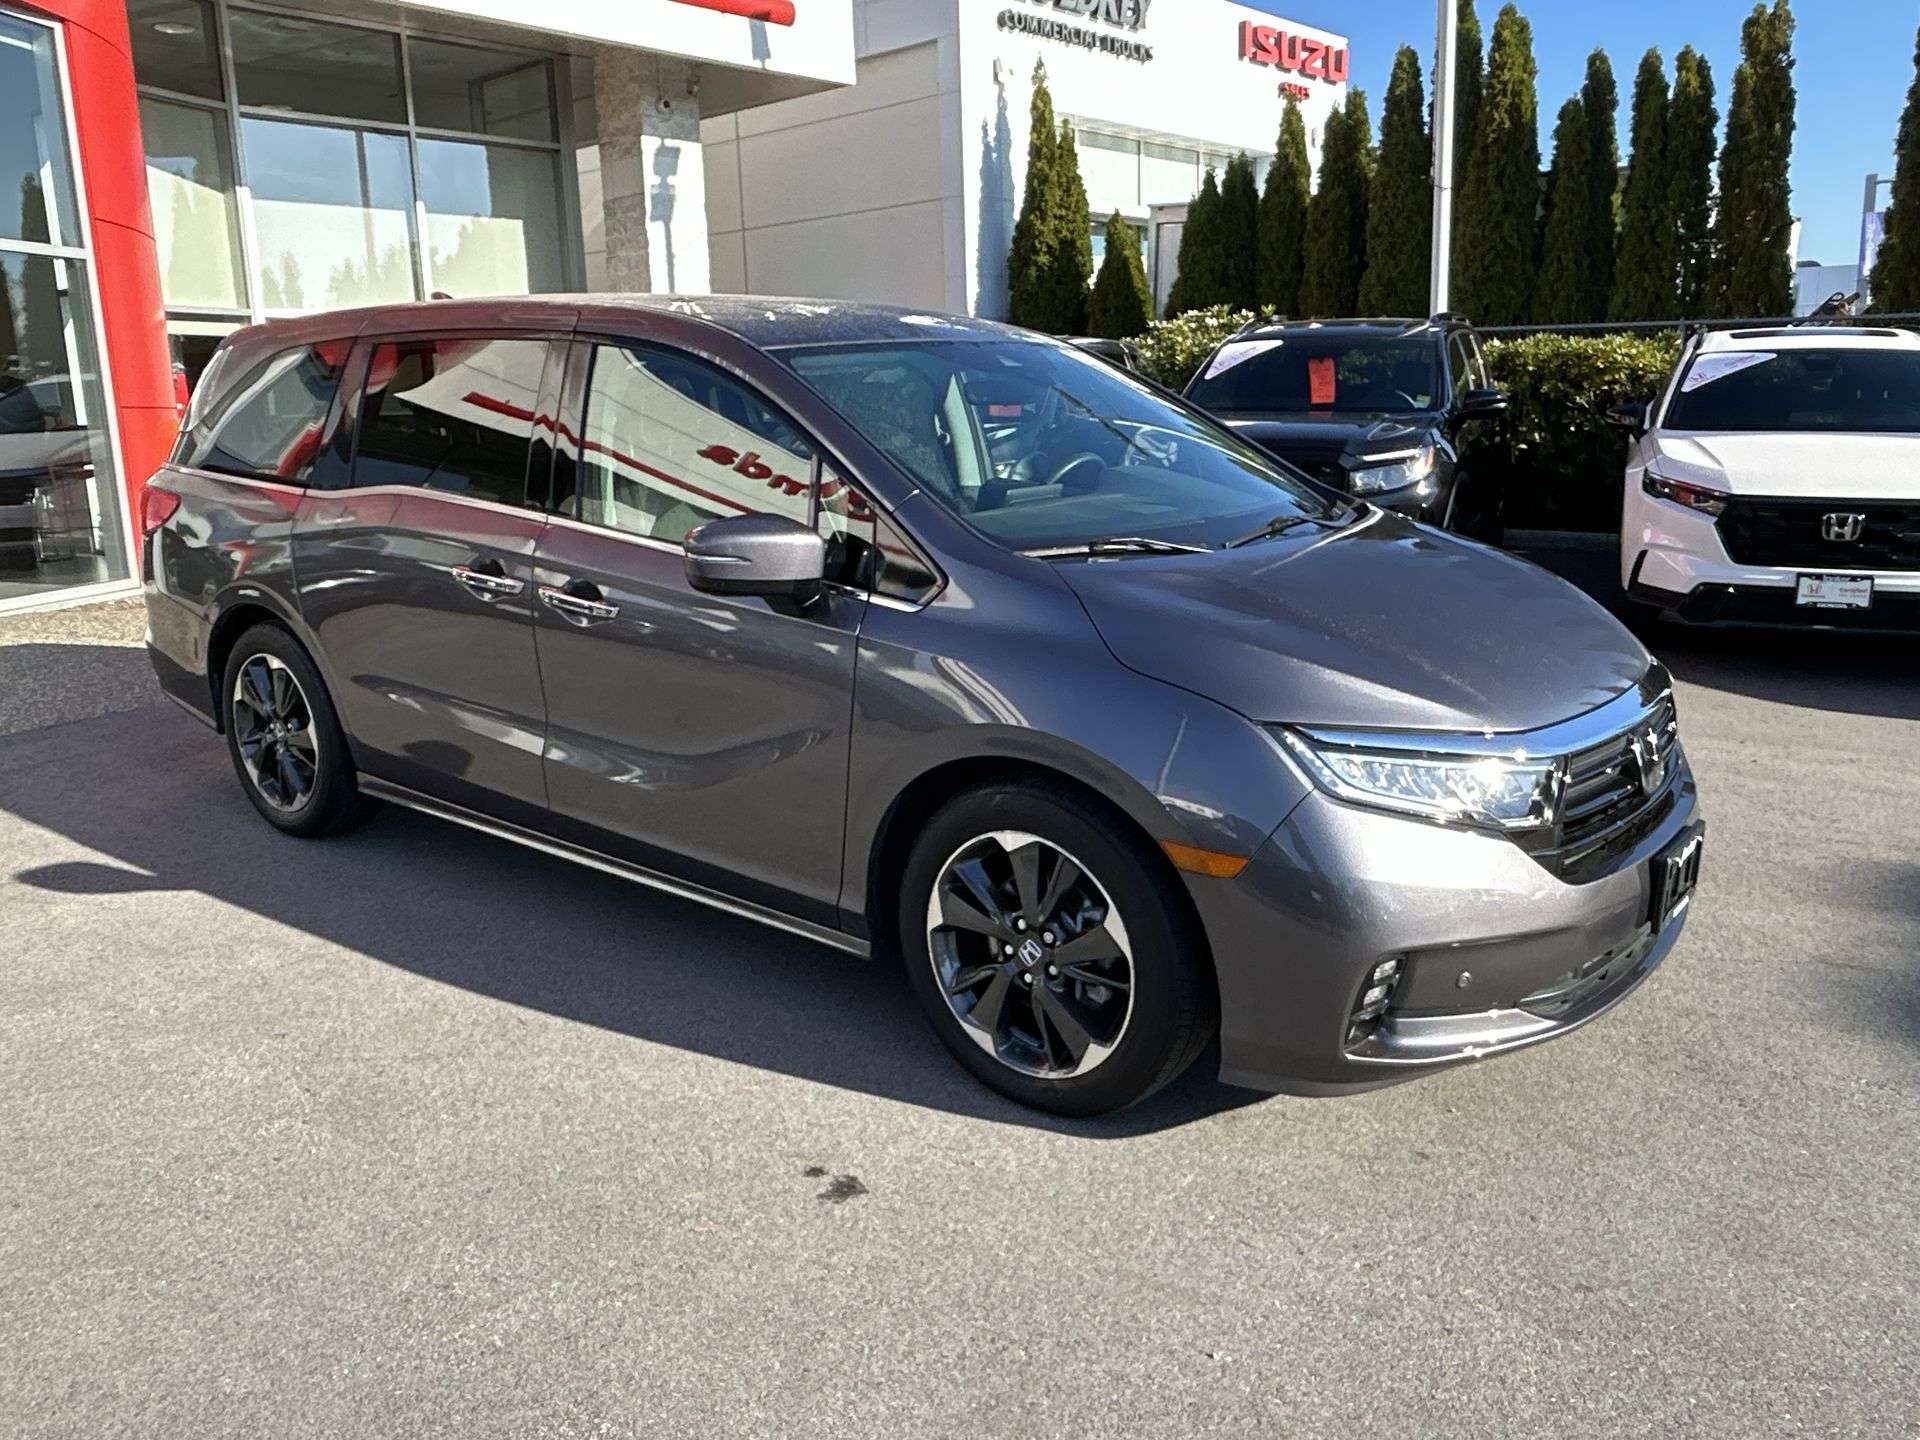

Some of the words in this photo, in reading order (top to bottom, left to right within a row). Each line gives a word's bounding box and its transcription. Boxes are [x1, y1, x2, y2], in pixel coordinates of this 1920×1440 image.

[998, 9, 1100, 50] COMMERCIAL
[1101, 35, 1153, 63] TRUCKS
[1239, 20, 1348, 84] ISUZU
